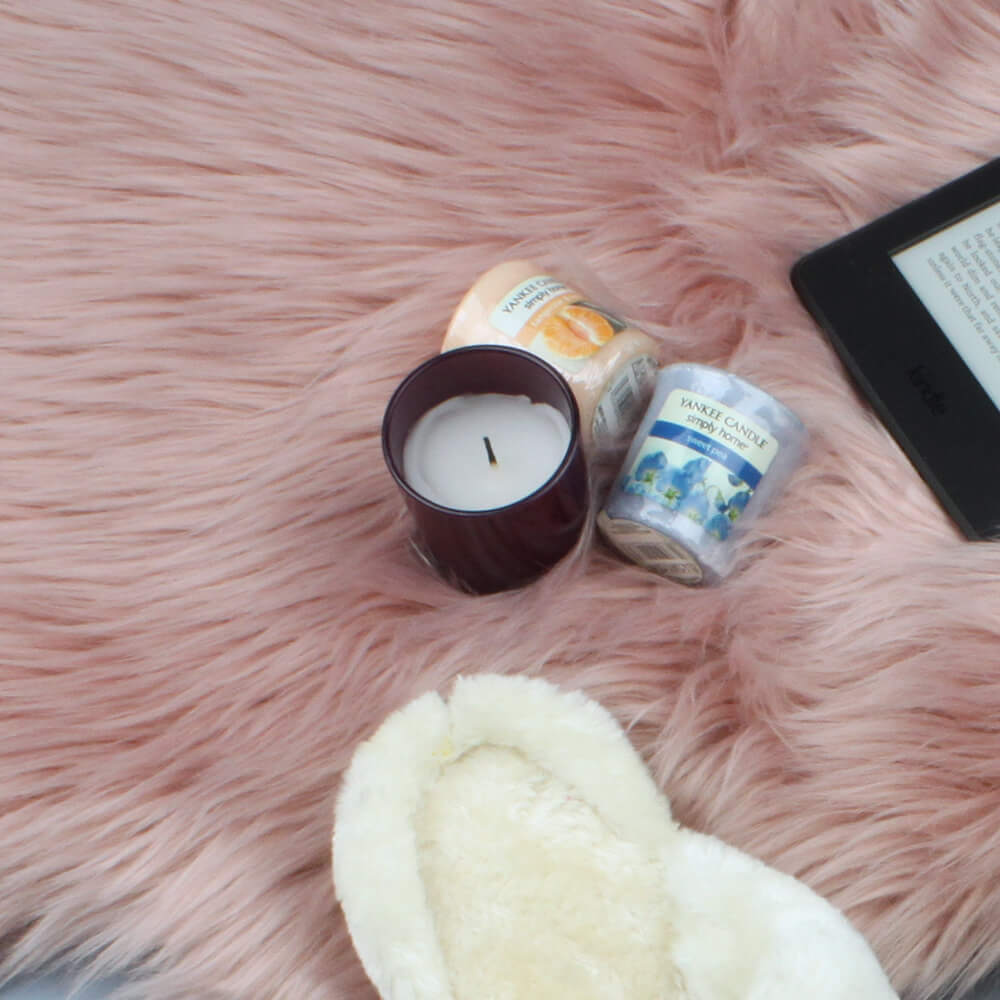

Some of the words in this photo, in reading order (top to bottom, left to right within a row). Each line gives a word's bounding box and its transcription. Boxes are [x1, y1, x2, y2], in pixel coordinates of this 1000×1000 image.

[680, 397, 724, 421] YANKEE
[724, 415, 769, 448] CANDLE
[686, 414, 717, 434] simply
